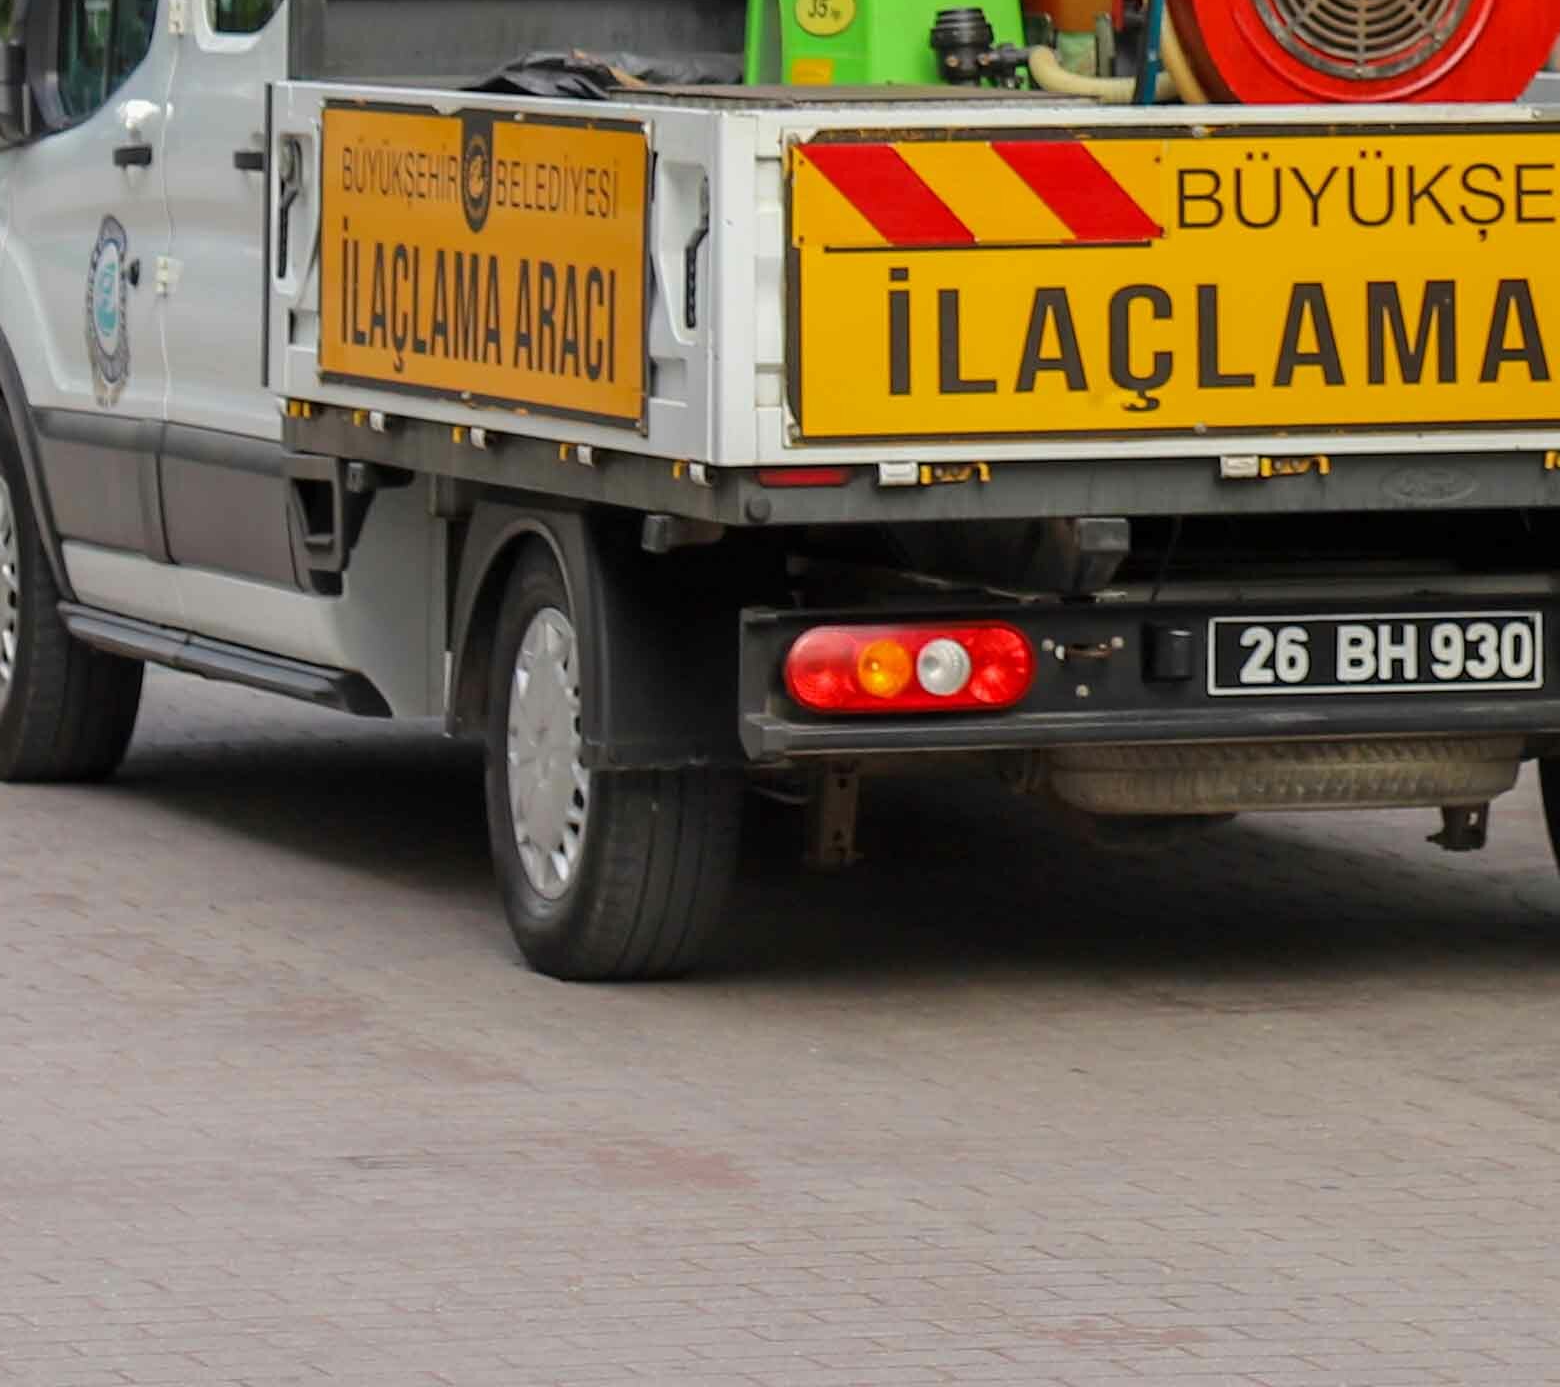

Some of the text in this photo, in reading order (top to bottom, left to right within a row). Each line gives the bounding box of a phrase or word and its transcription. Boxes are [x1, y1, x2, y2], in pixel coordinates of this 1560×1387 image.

[342, 137, 620, 219] BÜYÜKŞEHİR BELEDİYESİ
[341, 215, 617, 385] İLAÇLAMA ARACI
[887, 266, 1552, 413] İLAÇLAMA
[1238, 620, 1535, 686] 26 BH 930
